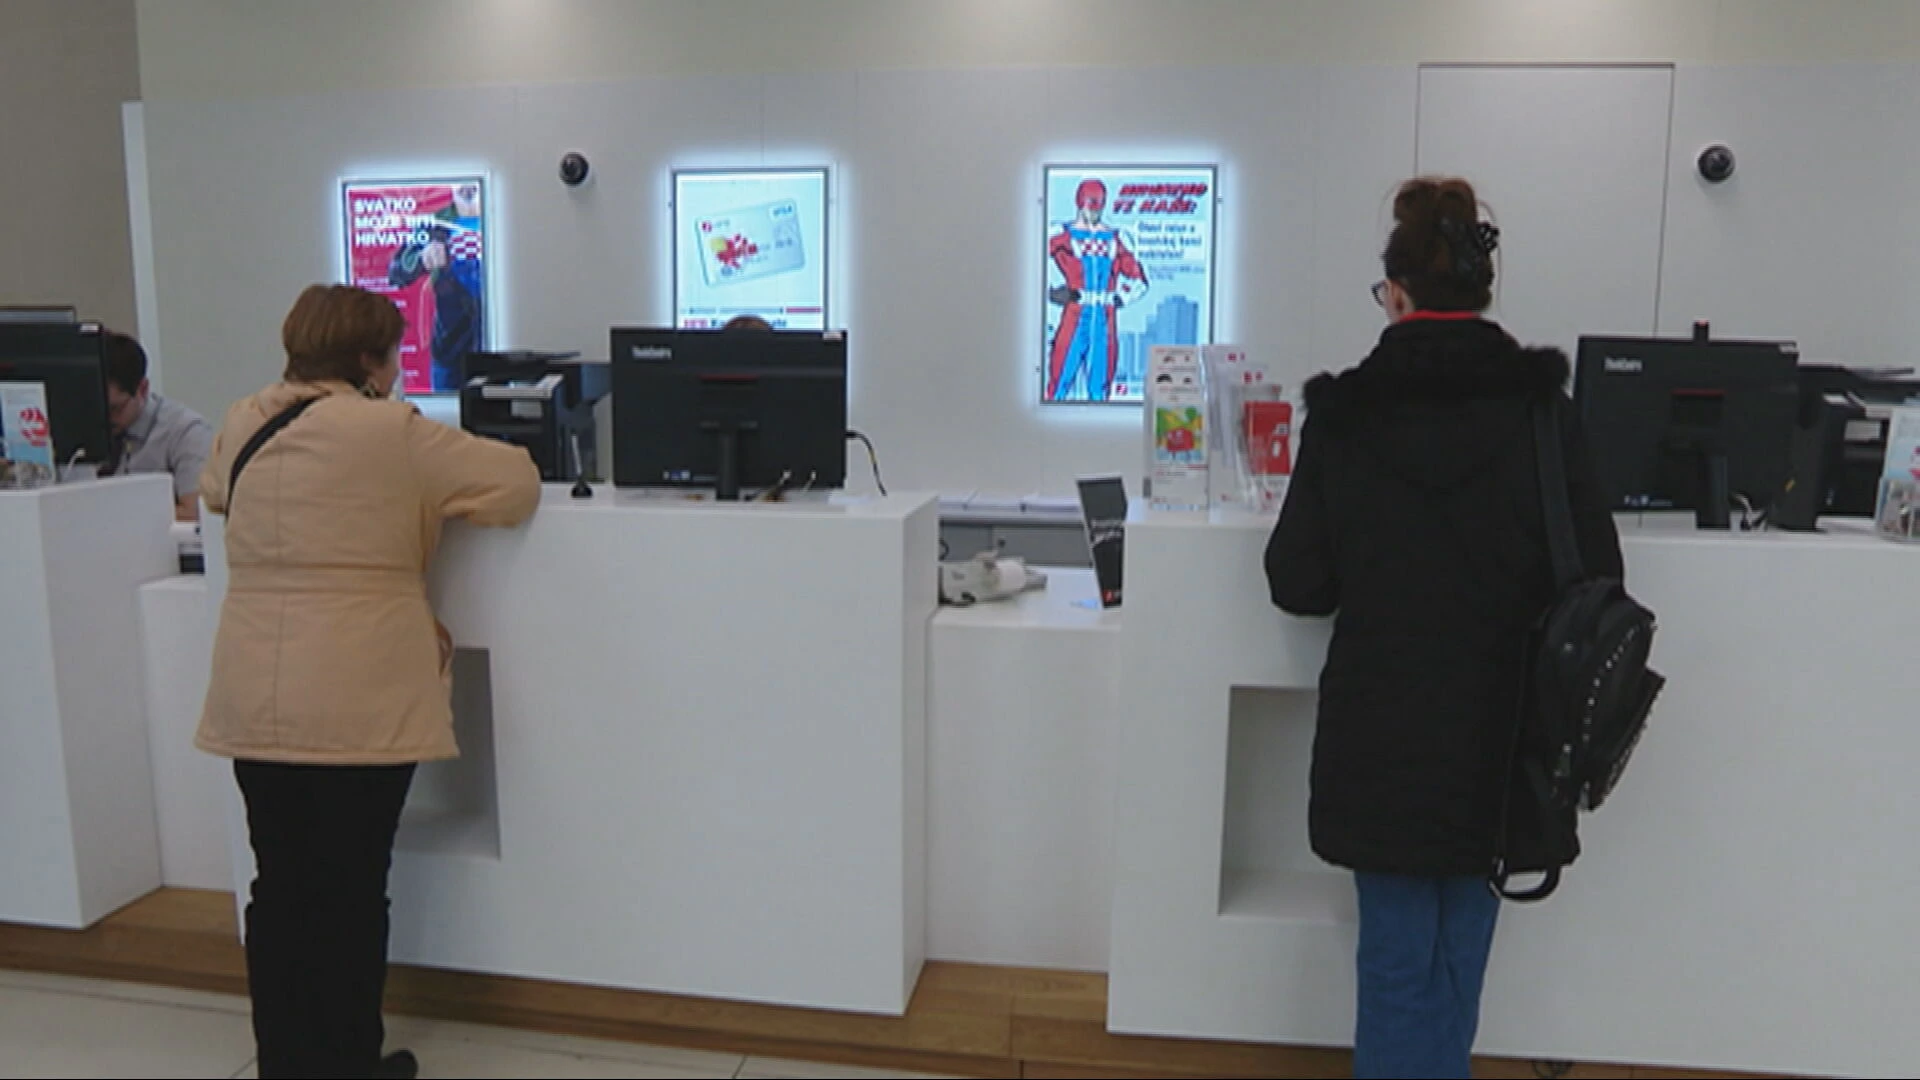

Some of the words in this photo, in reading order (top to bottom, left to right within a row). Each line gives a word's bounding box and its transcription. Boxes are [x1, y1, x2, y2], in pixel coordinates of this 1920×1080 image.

[354, 197, 417, 213] SVATKO
[354, 213, 401, 229] MOŽE
[406, 213, 435, 229] BITI
[354, 231, 430, 247] HRVATKO
